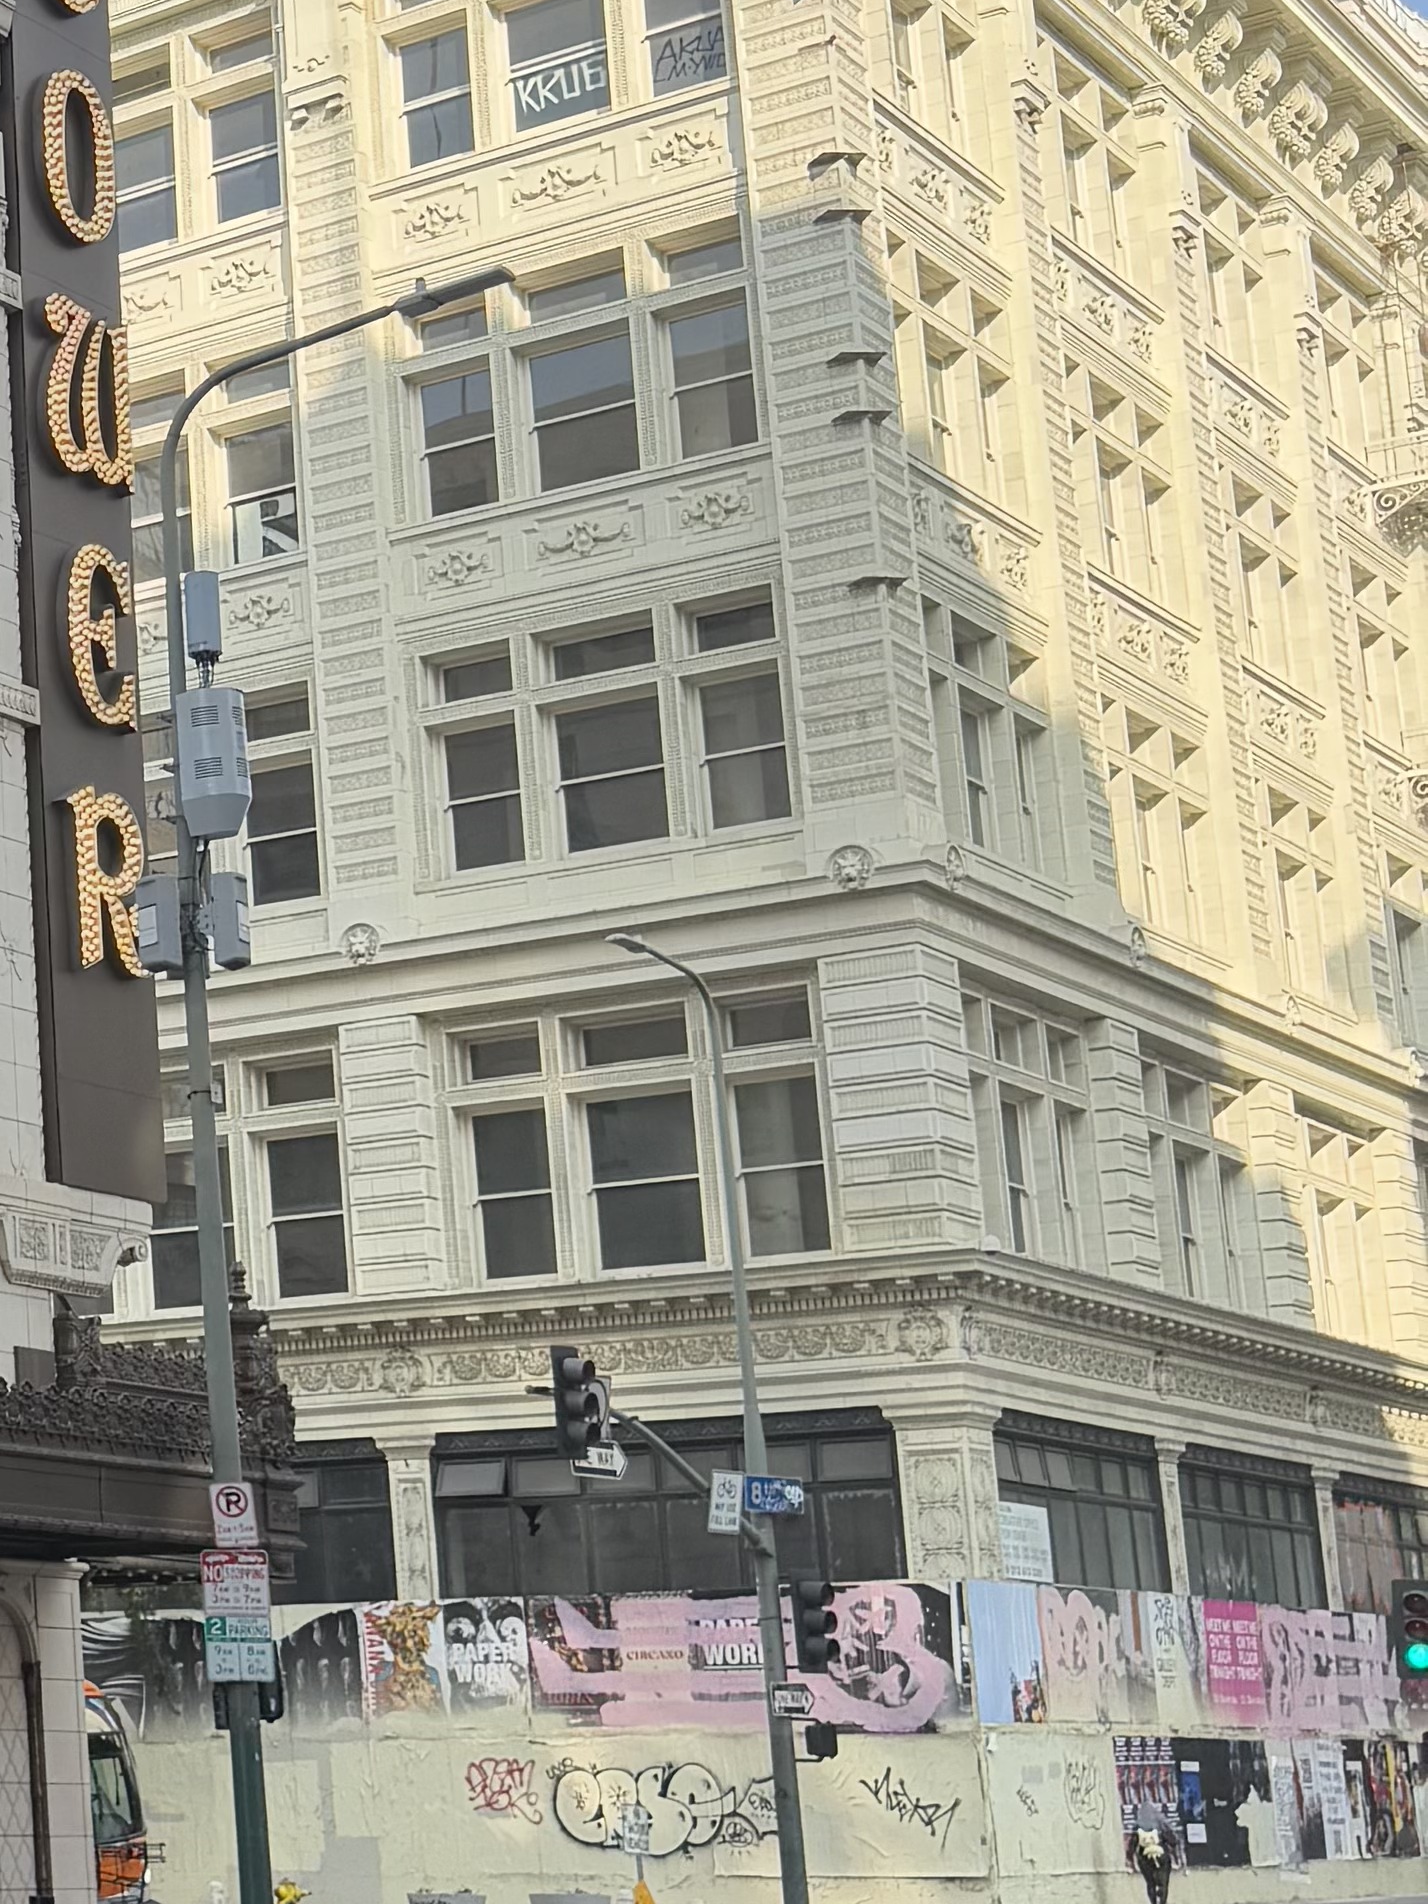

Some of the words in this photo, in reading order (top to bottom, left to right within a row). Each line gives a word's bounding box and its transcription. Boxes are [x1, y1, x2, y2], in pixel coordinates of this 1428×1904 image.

[204, 1565, 222, 1582] NO
[210, 1619, 222, 1634] 2
[452, 1643, 514, 1663] PAPER
